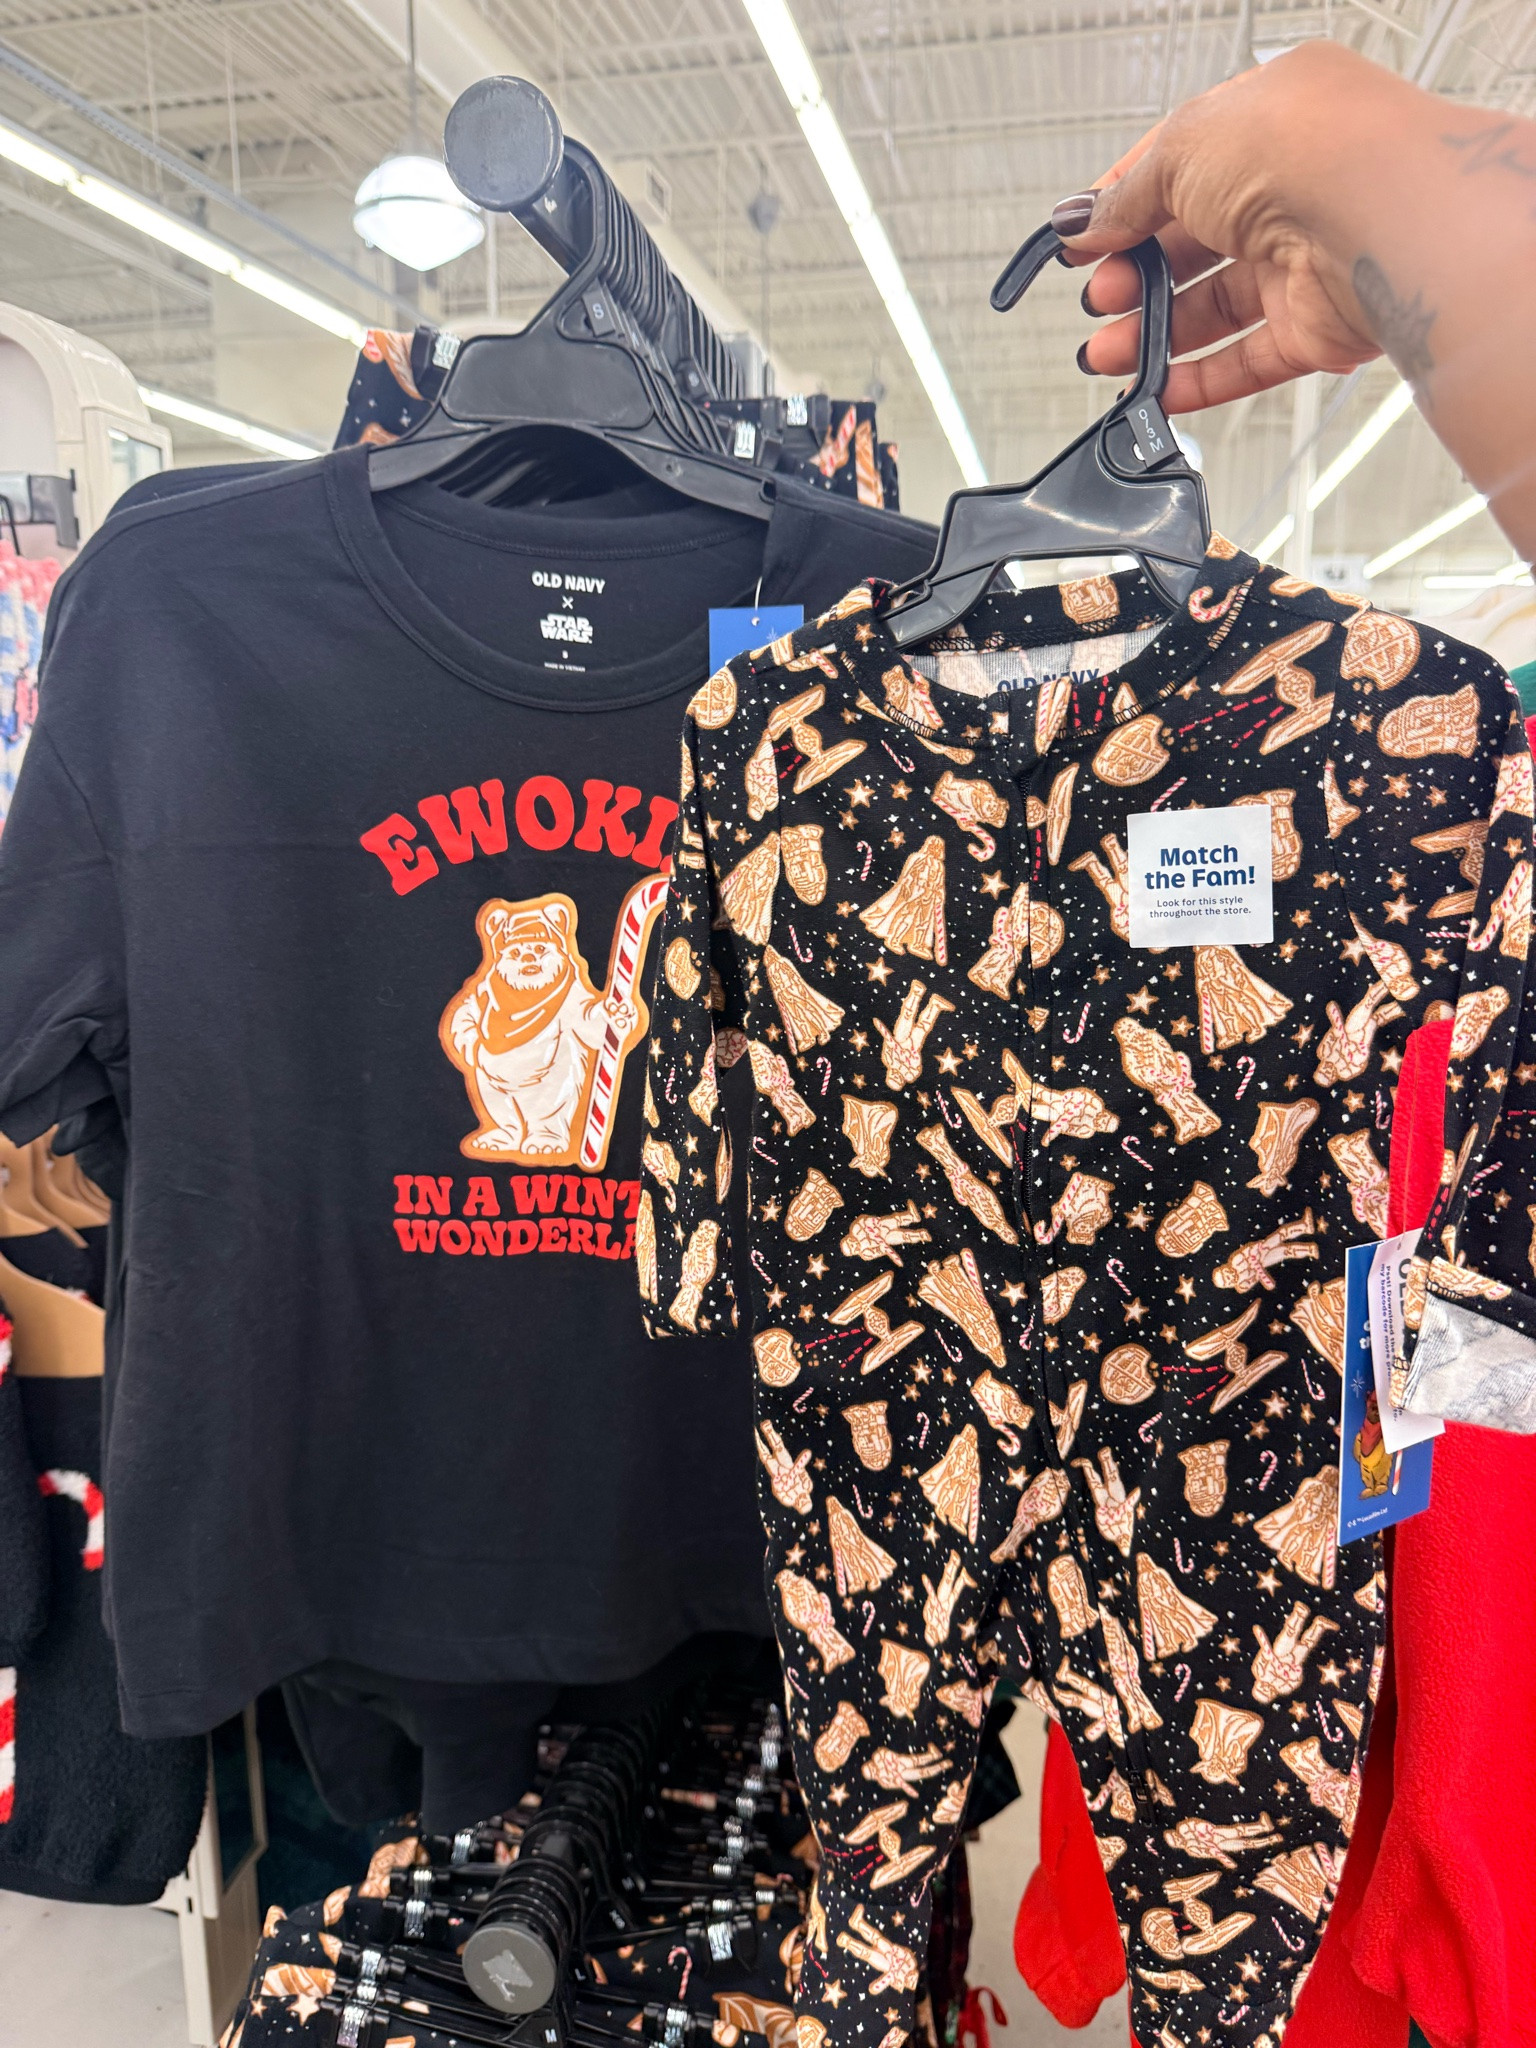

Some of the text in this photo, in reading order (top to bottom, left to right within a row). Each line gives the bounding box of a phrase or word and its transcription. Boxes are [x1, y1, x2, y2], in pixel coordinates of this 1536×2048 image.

[531, 570, 606, 594] OLD NAVY
[540, 613, 593, 632] STAR
[360, 775, 680, 896] EWOKI
[1160, 845, 1238, 867] Match
[1144, 866, 1255, 890] the Fam!
[1150, 907, 1251, 919] throughout the store.
[1157, 896, 1243, 908] Look for this style
[393, 1175, 453, 1216] IN
[462, 1176, 501, 1216] A
[1380, 1263, 1385, 1277] my
